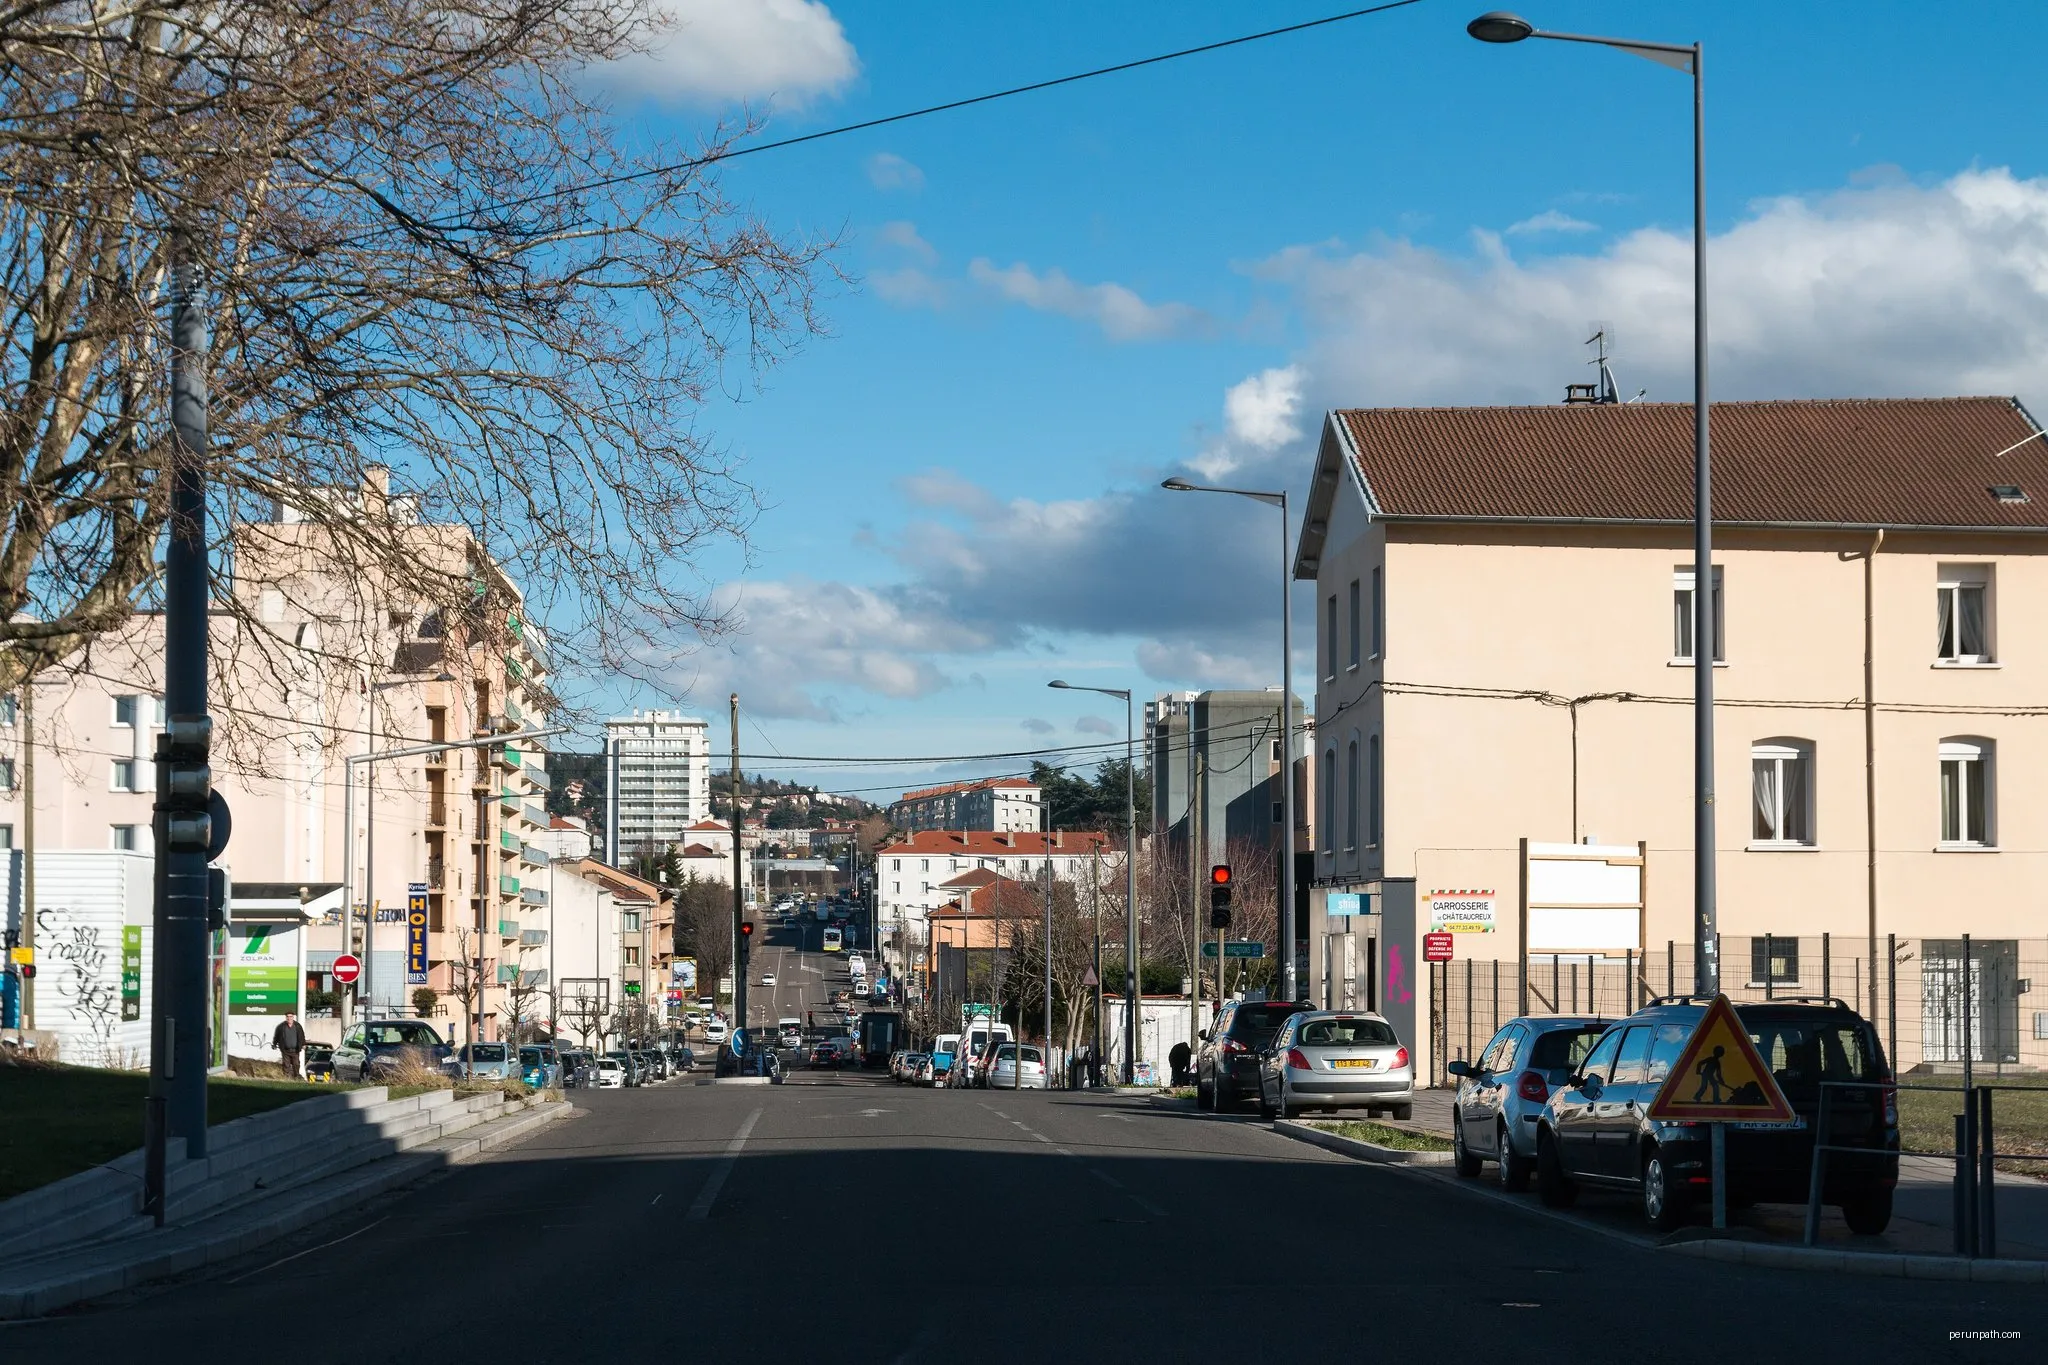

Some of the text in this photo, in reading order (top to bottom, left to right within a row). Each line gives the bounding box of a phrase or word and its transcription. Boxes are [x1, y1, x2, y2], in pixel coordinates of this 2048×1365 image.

[1433, 902, 1488, 910] CARROSSERIE
[1442, 912, 1492, 920] CHÂTEAUCREUX
[409, 898, 426, 971] HOTEL
